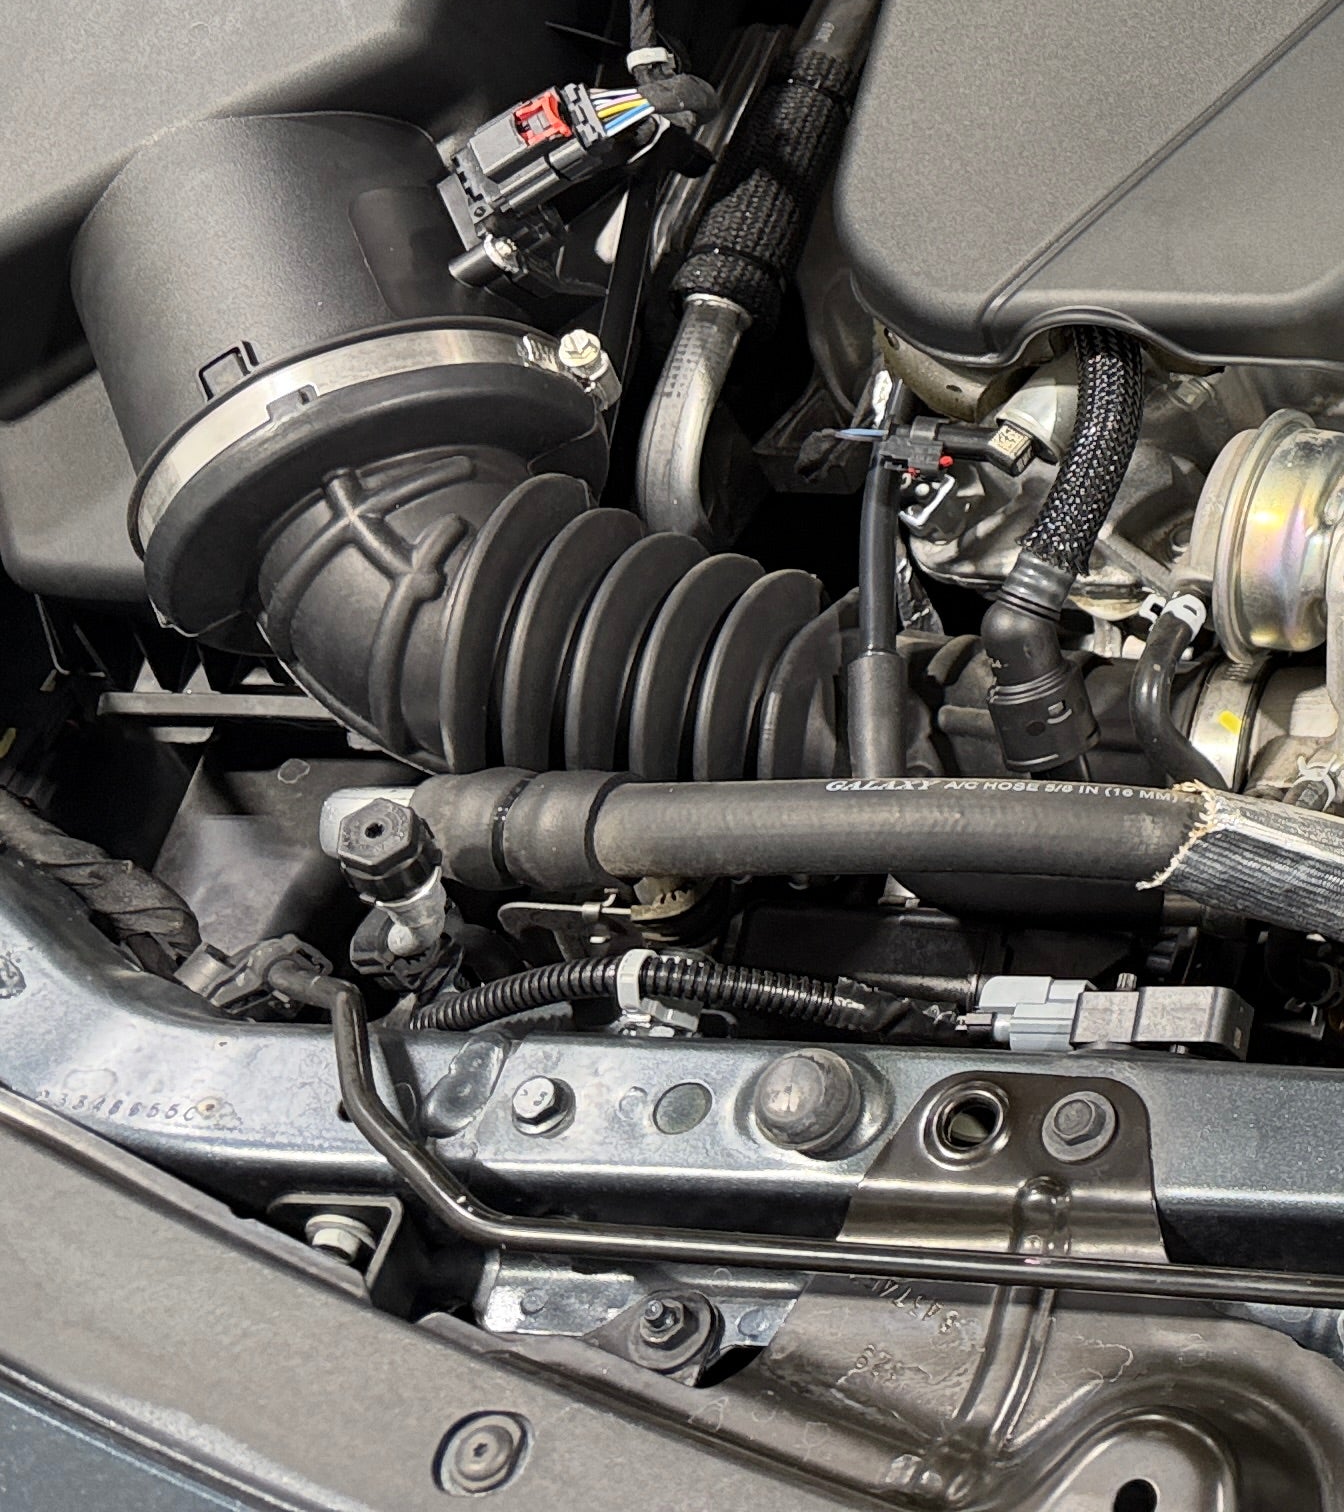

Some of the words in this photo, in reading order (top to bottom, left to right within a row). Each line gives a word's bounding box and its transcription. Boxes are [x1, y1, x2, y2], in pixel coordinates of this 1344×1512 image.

[826, 780, 941, 792] GALAXY
[943, 781, 979, 790] A/C
[983, 782, 1039, 792] HOSE
[1045, 783, 1073, 793] 5/8
[1078, 785, 1100, 795] IN
[1139, 790, 1178, 803] MM)
